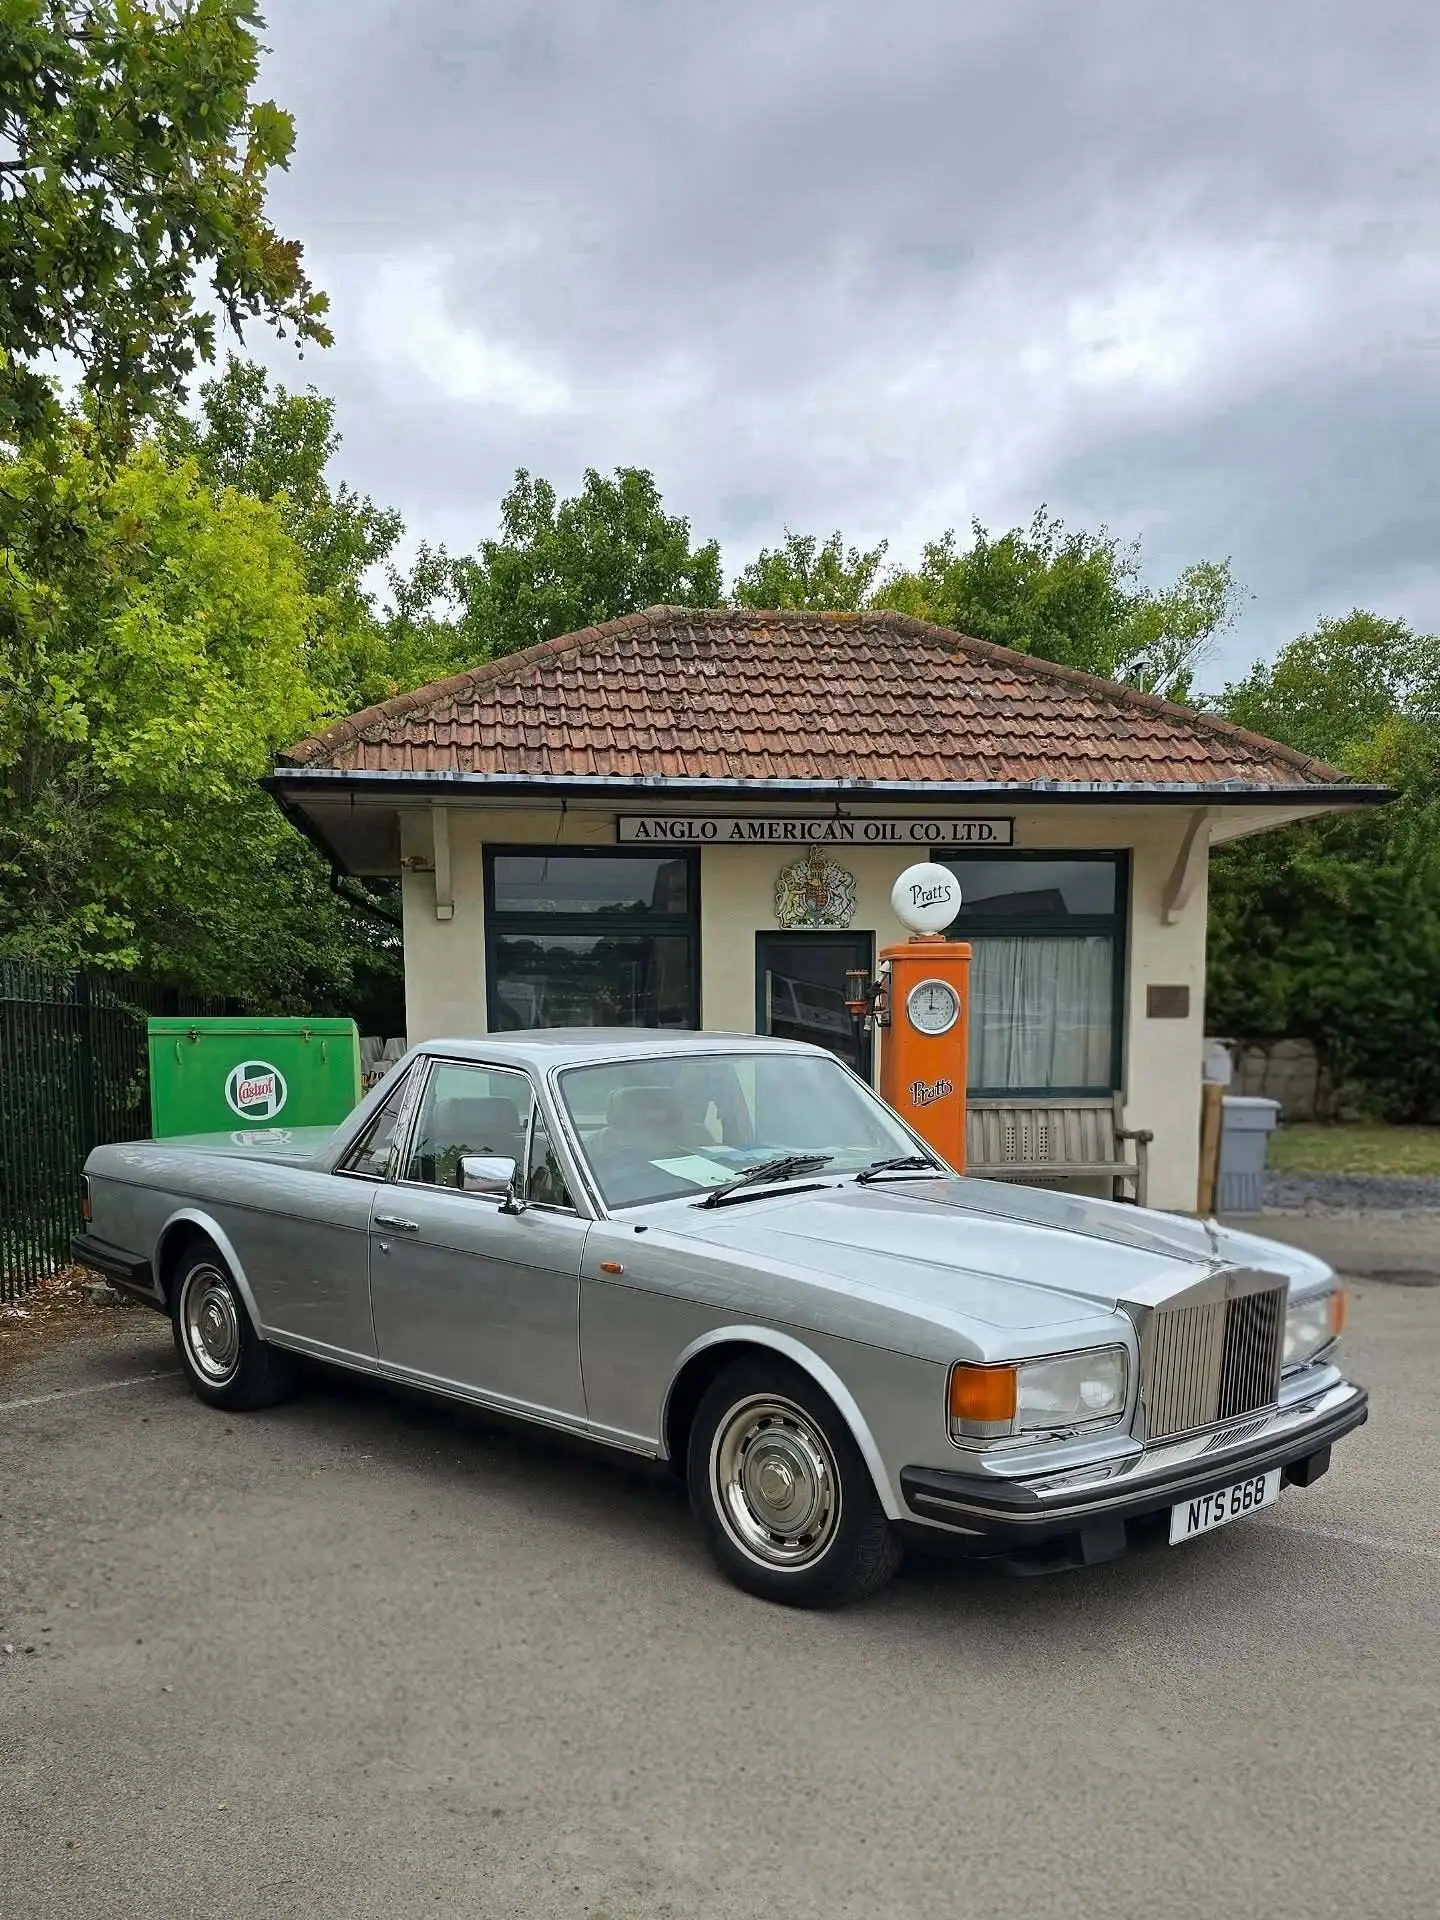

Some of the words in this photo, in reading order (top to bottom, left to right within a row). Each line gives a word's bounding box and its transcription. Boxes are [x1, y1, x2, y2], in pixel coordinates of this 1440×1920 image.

[635, 821, 718, 839] ANGLO
[729, 821, 854, 840] AMERICAN
[863, 823, 902, 840] OIL
[909, 823, 945, 841] CO.
[951, 823, 997, 841] LTD.
[239, 1077, 273, 1104] Castrol
[909, 1079, 954, 1107] Pratts
[1187, 1491, 1226, 1533] NTS
[1230, 1475, 1266, 1515] 668
